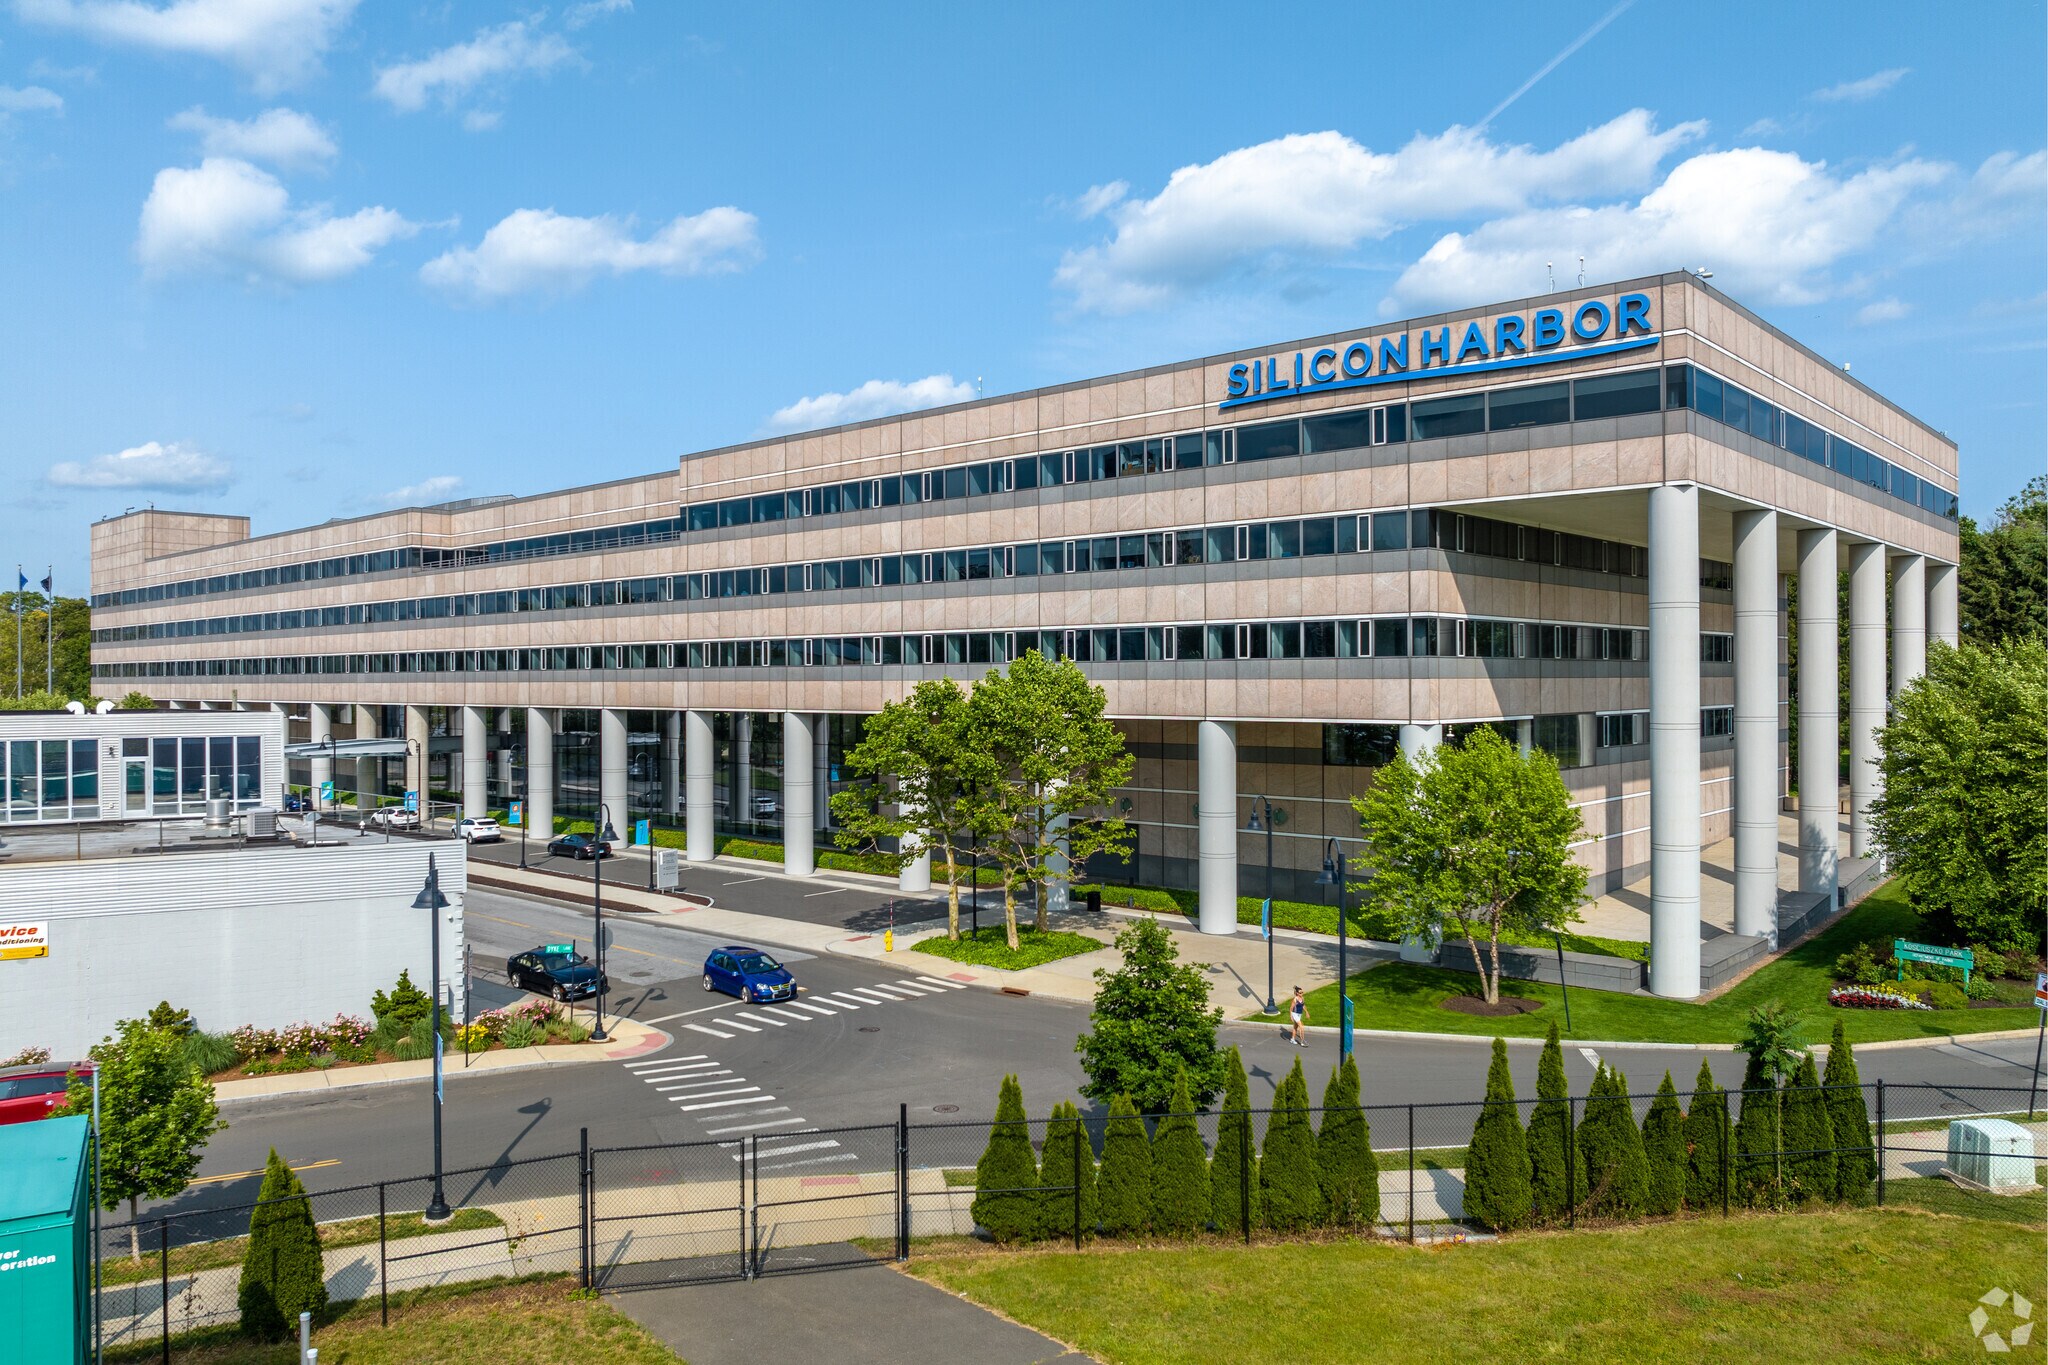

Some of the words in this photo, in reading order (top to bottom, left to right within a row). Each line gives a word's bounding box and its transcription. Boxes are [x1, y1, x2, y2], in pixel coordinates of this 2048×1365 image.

[1227, 334, 1408, 396] SILICON
[1421, 292, 1653, 365] HARBOR
[0, 926, 38, 937] vice
[1904, 943, 1943, 955] KOSCIUSZKO
[1945, 949, 1963, 957] PARK
